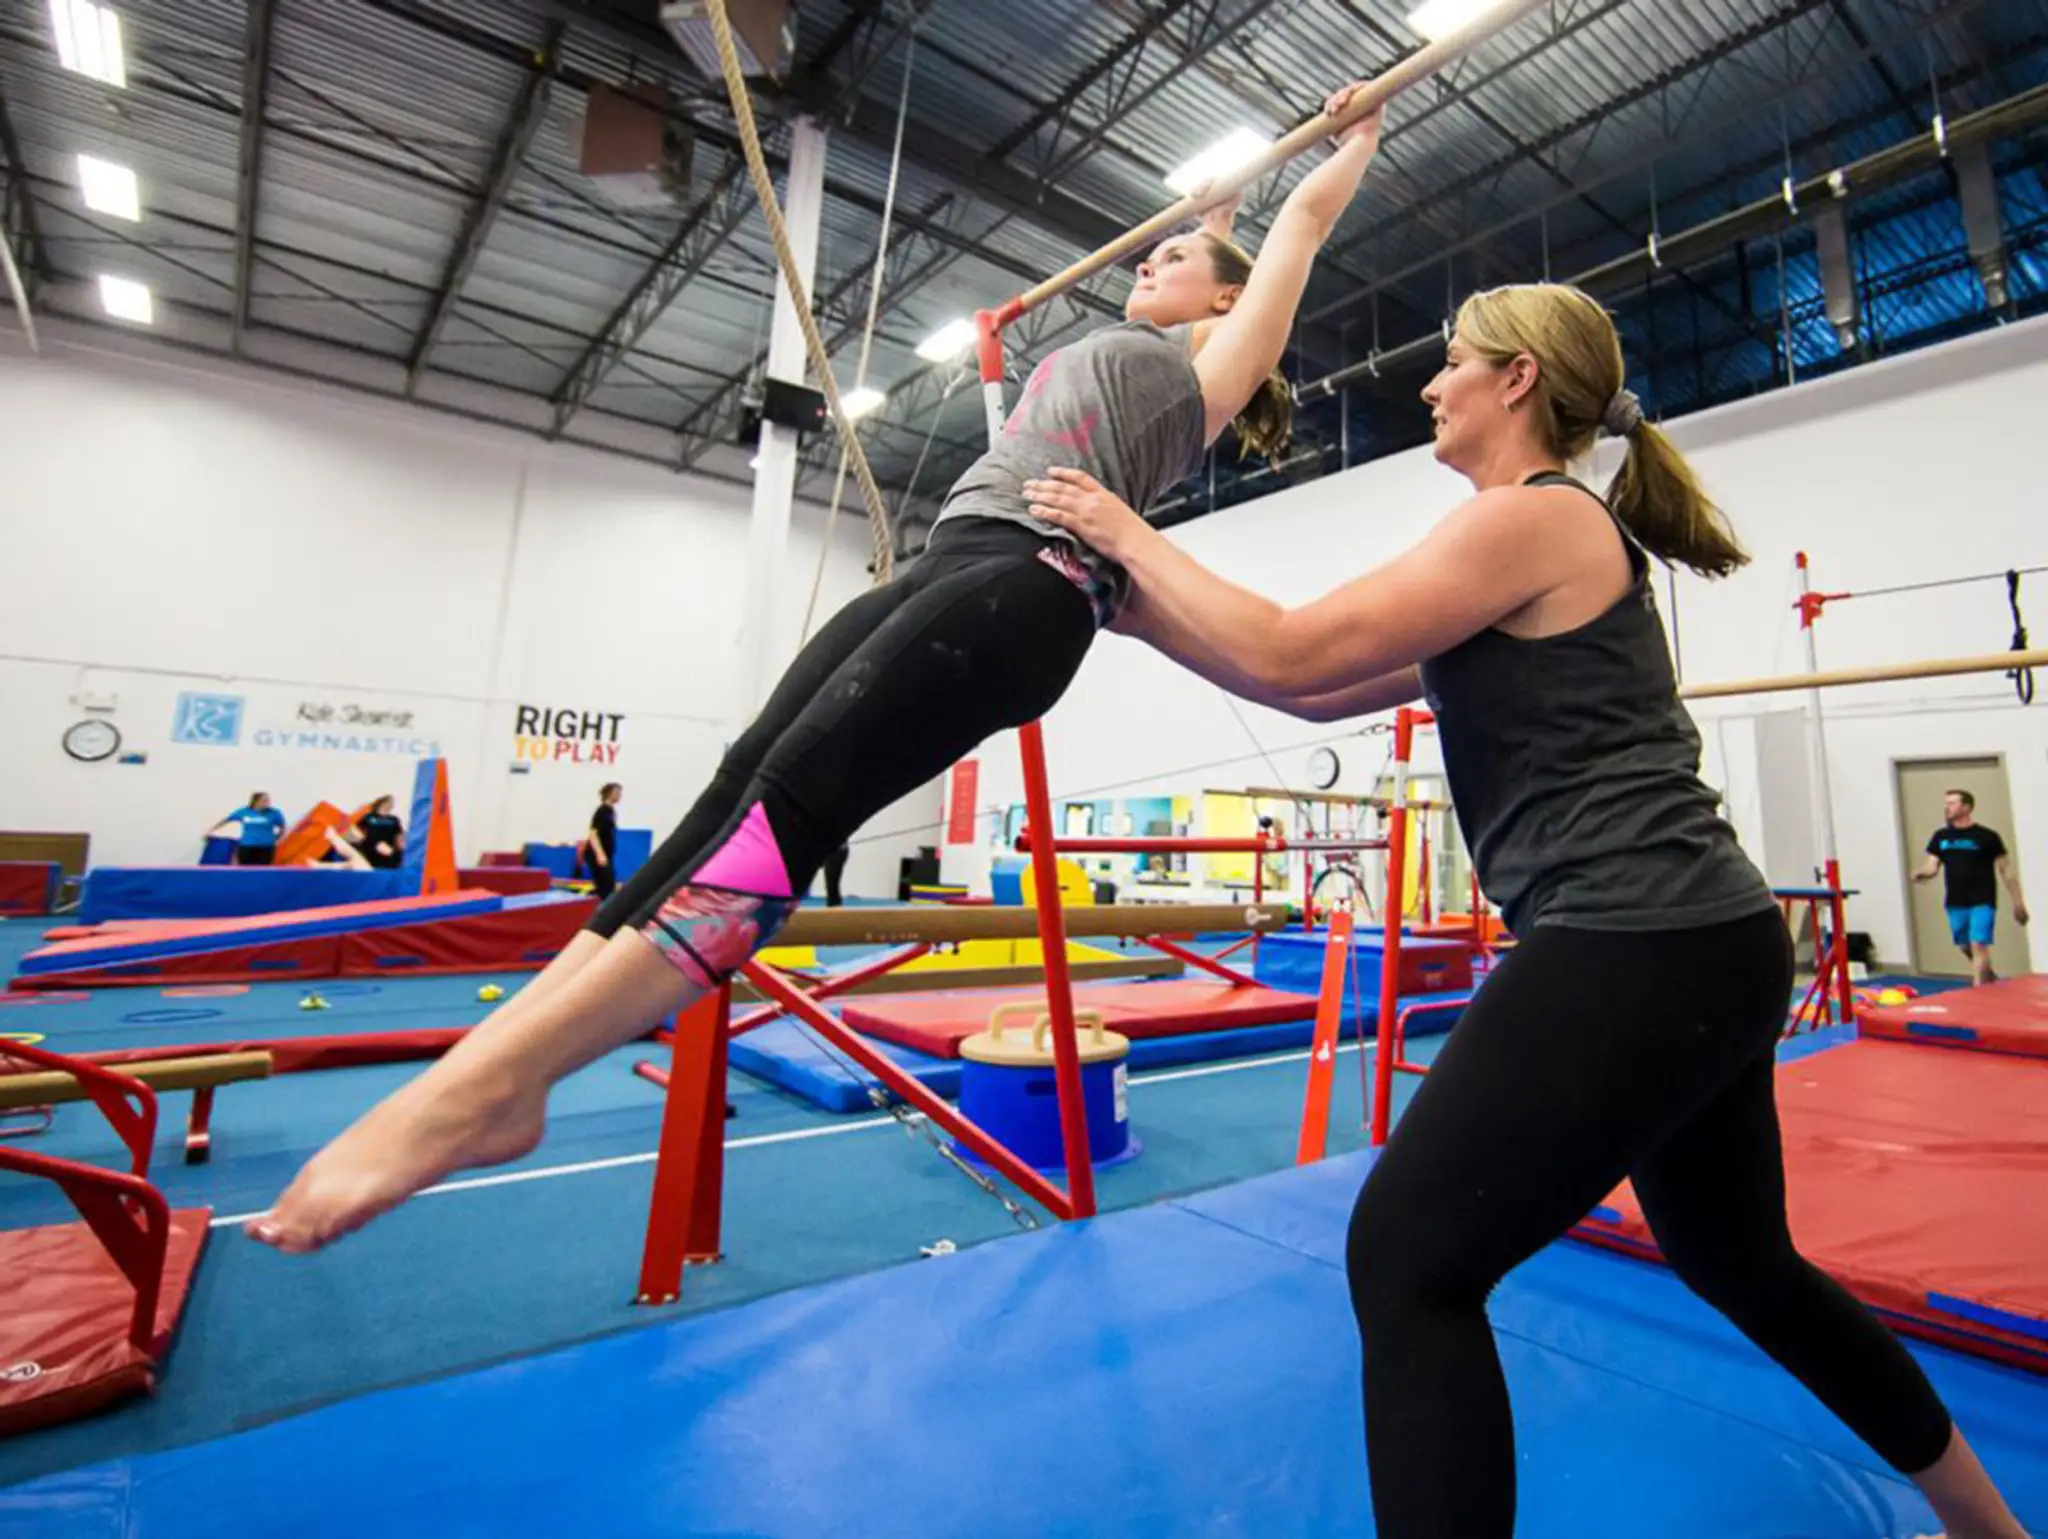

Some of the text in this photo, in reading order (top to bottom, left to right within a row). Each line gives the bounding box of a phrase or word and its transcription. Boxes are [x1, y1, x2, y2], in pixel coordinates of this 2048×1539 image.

[515, 704, 626, 742] RIGHT
[253, 729, 441, 756] GYMNASTICS
[514, 737, 621, 764] TO PLAY
